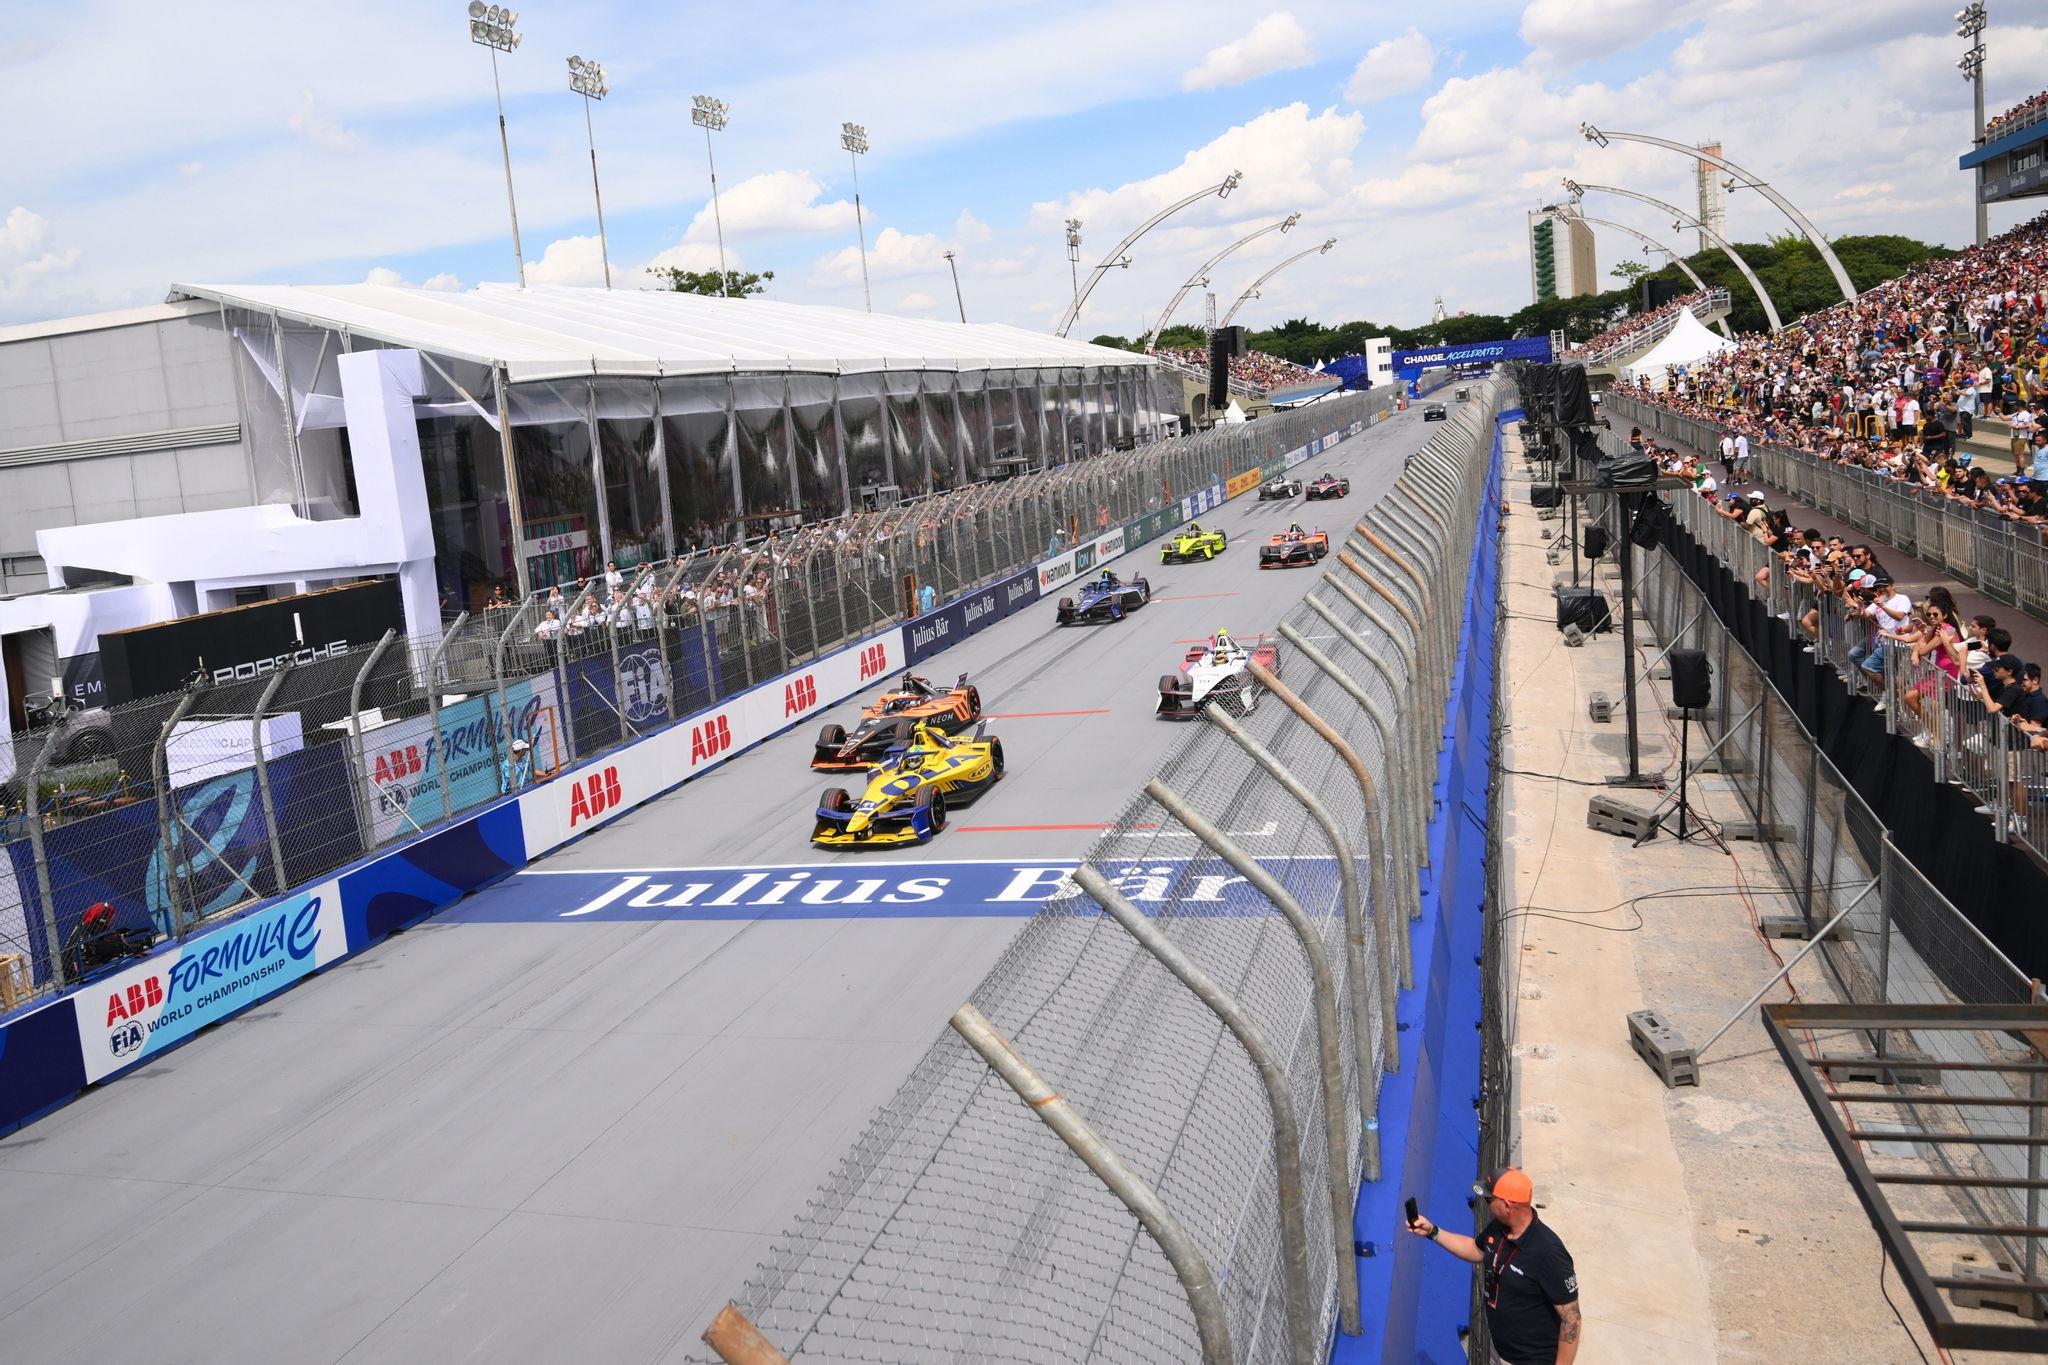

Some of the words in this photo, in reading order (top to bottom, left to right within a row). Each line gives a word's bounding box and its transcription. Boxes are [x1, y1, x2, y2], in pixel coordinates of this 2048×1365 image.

[1007, 583, 1024, 606] Julius
[1023, 576, 1033, 593] Bär
[963, 602, 984, 628] Julius
[982, 595, 995, 615] Bär
[912, 624, 935, 653] Julius
[935, 617, 949, 638] Bär
[213, 639, 349, 686] PORSCHE
[861, 643, 886, 681] ABB
[785, 674, 817, 718] ABB
[930, 712, 954, 724] NEOM
[691, 714, 731, 766] ABB
[375, 746, 422, 785] ABB
[971, 764, 990, 779] LOLA
[410, 779, 440, 798] WORL
[570, 766, 622, 827] ABB
[561, 871, 951, 917] Julius
[984, 867, 1250, 902] Bär
[107, 976, 163, 1027] ABB
[168, 914, 287, 1003] FORMULA
[147, 1004, 193, 1033] WORLD
[197, 958, 287, 1009] CHAMPIONSHIP
